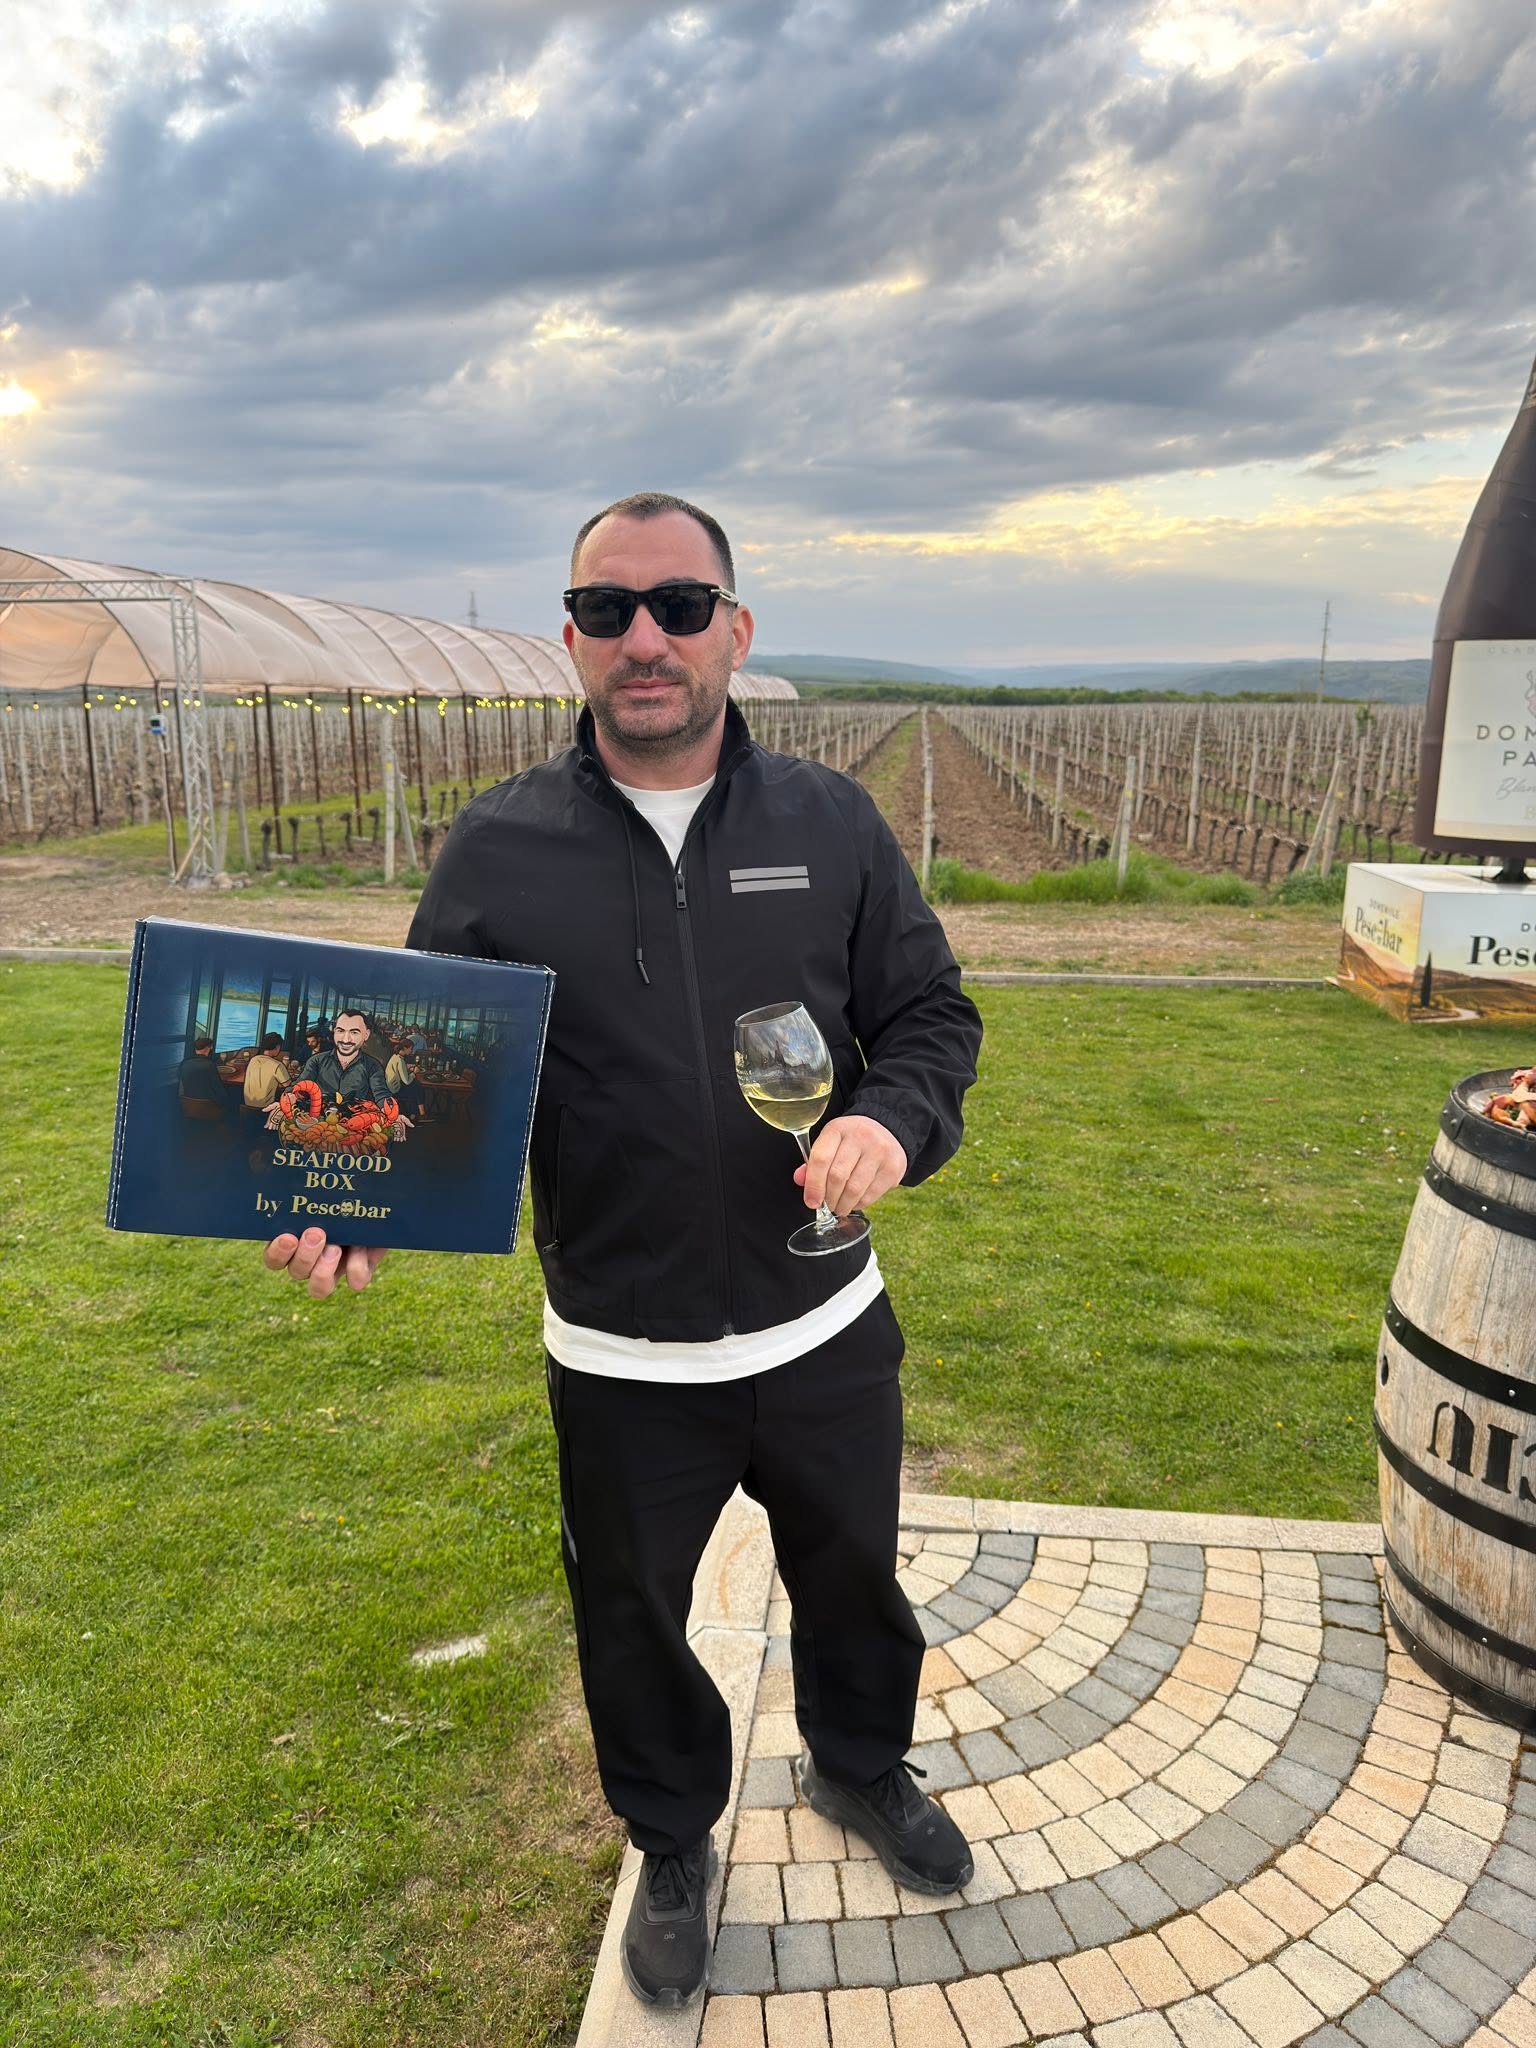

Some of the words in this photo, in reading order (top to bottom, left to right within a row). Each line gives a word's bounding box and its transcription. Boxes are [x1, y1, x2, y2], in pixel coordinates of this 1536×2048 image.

[1521, 922, 1536, 932] D
[1466, 935, 1536, 967] Pes
[272, 1149, 392, 1173] SEAFOOD
[304, 1171, 356, 1191] BOX
[255, 1193, 283, 1218] by
